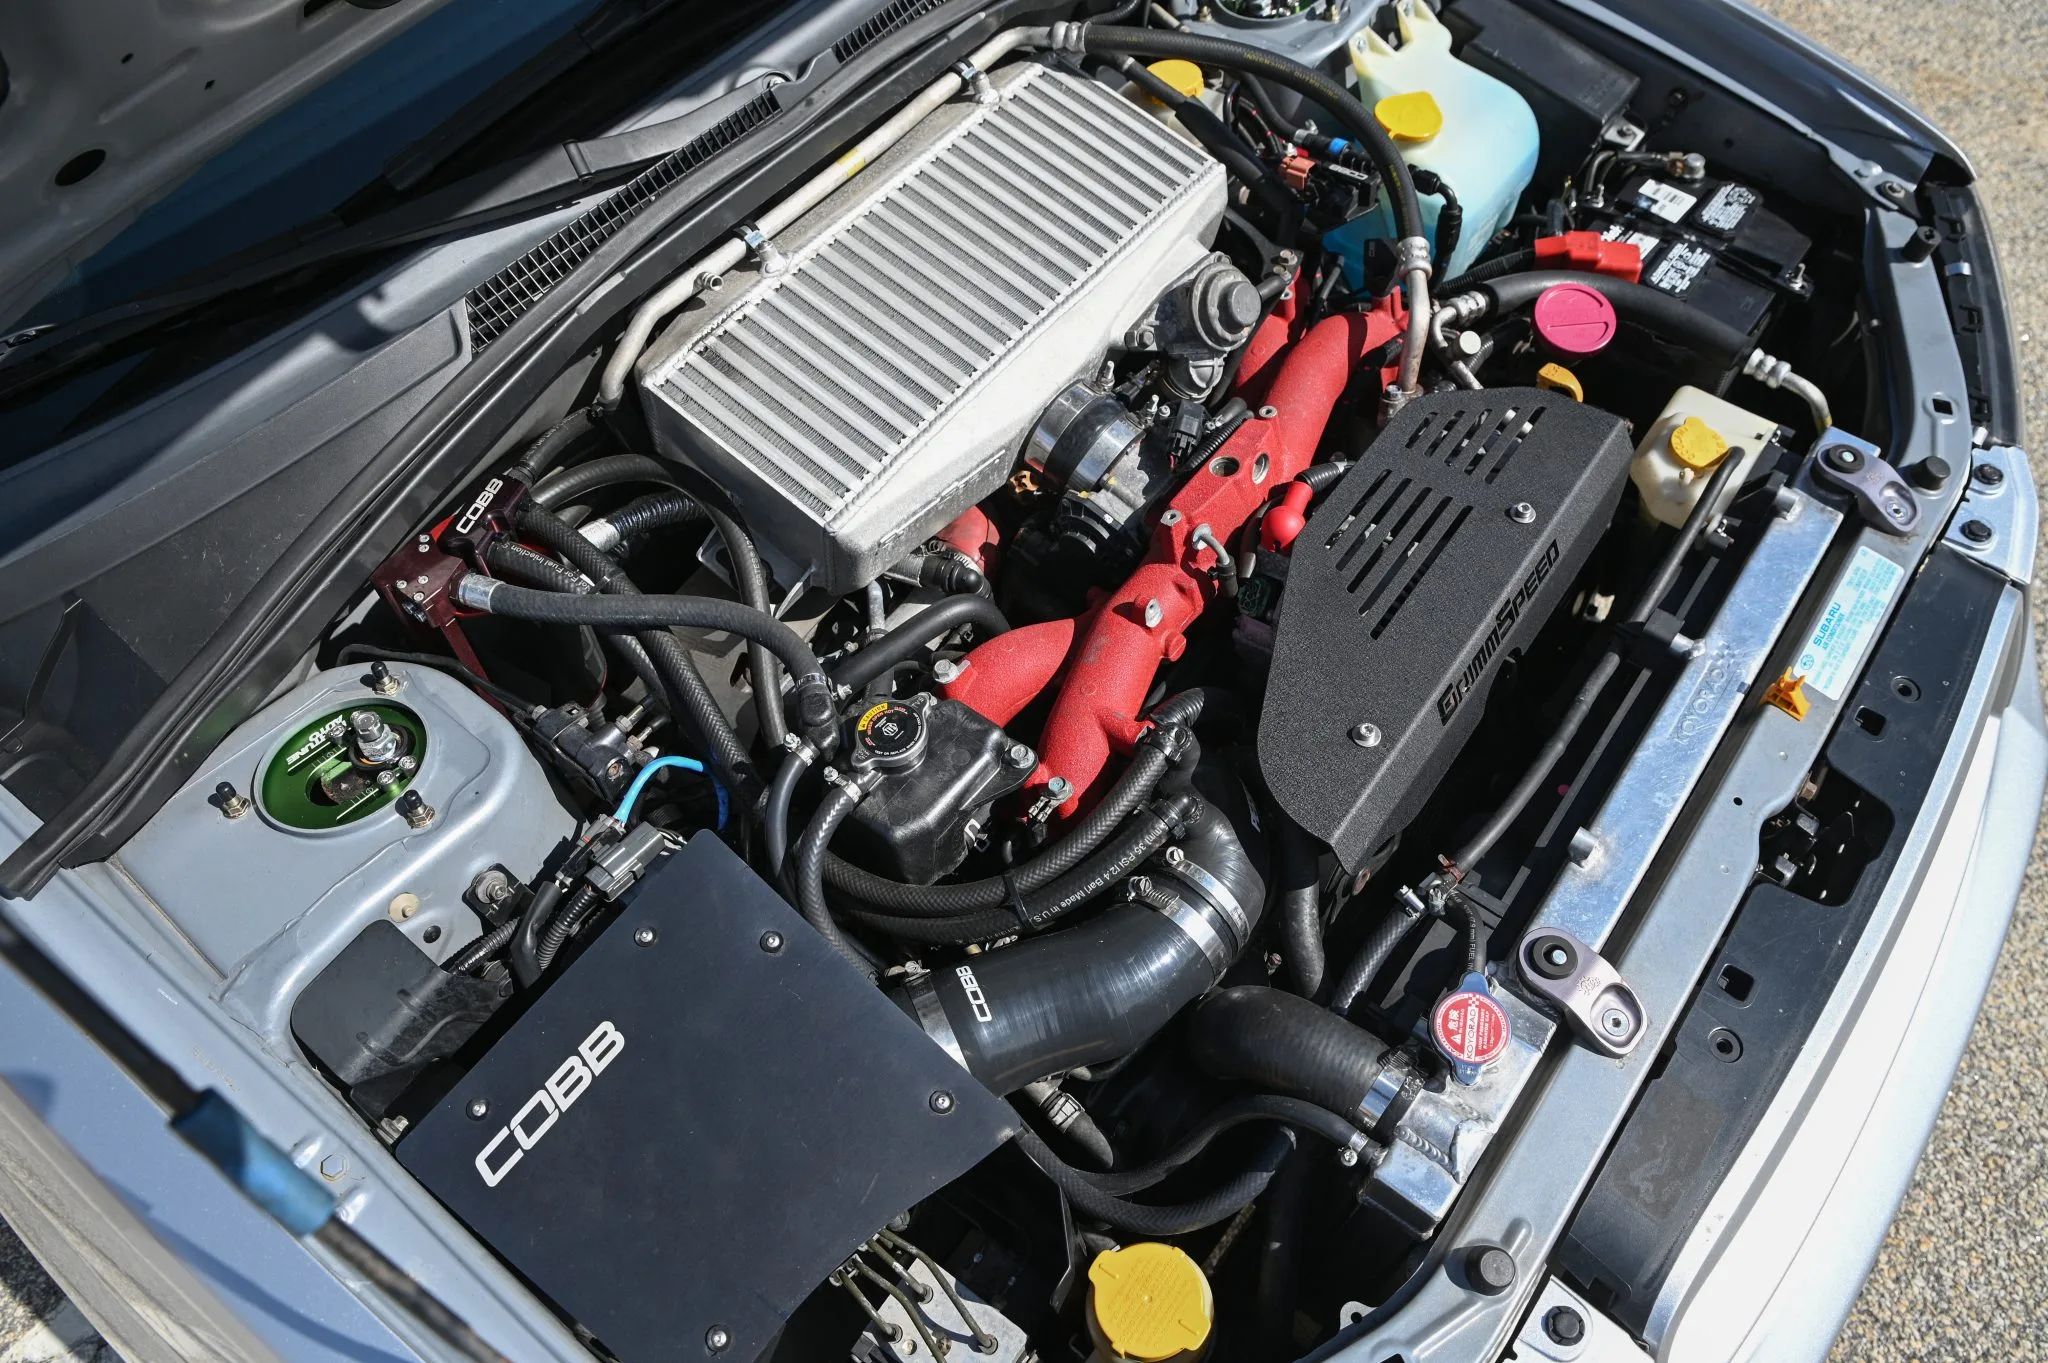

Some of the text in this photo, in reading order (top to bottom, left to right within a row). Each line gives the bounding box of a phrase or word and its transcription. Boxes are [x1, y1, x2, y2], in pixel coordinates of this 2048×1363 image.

[456, 477, 503, 534] COBB
[511, 545, 544, 563] Injection
[544, 561, 564, 573] Fuel
[564, 571, 579, 583] For
[1813, 602, 1841, 646] SUBARU
[286, 720, 347, 765] TUNE
[1117, 851, 1136, 868] PSI
[1059, 889, 1086, 908] Made
[956, 966, 992, 1022] COBB
[1466, 1008, 1476, 1059] KOYORAD
[475, 1021, 625, 1187] COBB
